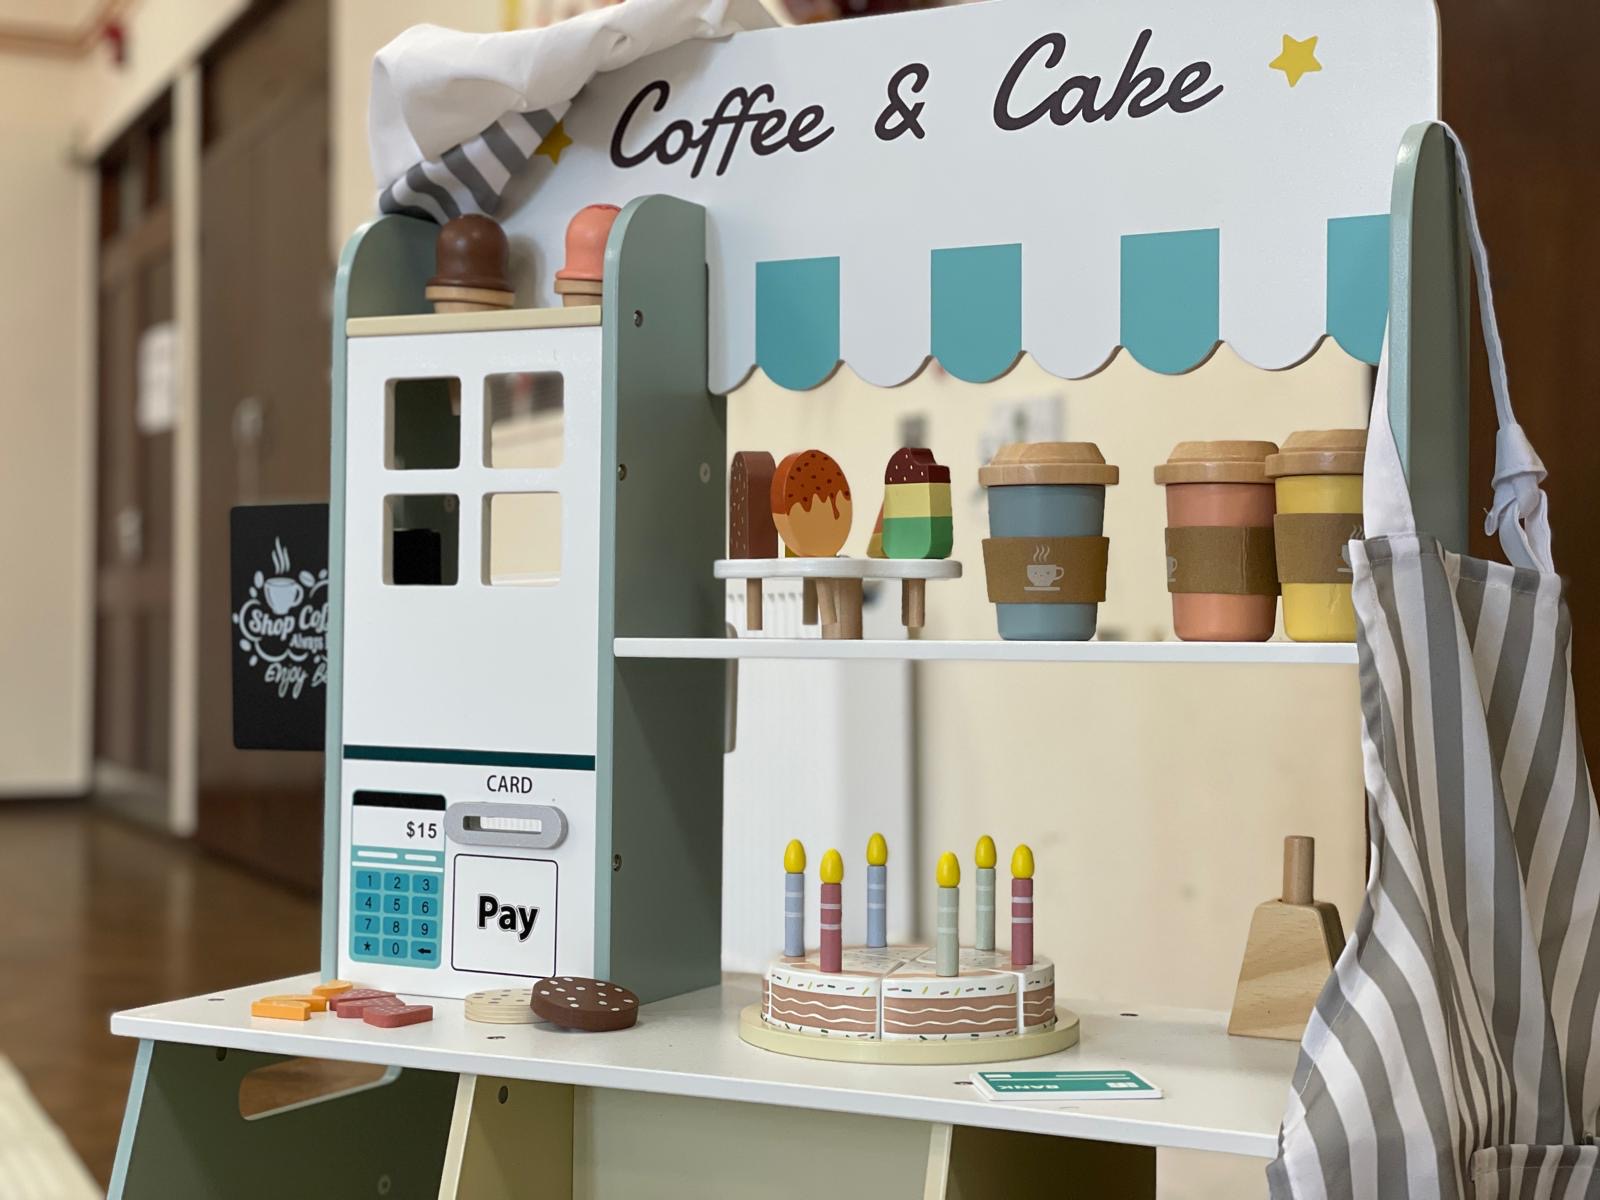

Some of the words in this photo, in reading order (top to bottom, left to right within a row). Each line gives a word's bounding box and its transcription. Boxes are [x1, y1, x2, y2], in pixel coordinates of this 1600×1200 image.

[609, 80, 834, 178] Coffee
[874, 62, 930, 141] &
[992, 28, 1224, 131] Cake
[248, 608, 295, 641] Shop
[264, 662, 309, 700] Enjoy
[486, 774, 533, 793] CARD
[406, 821, 437, 839] $15
[393, 876, 401, 889] 2
[422, 878, 430, 891] 3
[364, 896, 372, 908] 4
[392, 899, 401, 911] 5
[421, 901, 429, 914] 6
[364, 918, 372, 930] 7
[392, 921, 400, 933] 8
[421, 922, 429, 935] 9
[477, 893, 540, 942] Pay
[392, 943, 400, 955] 0
